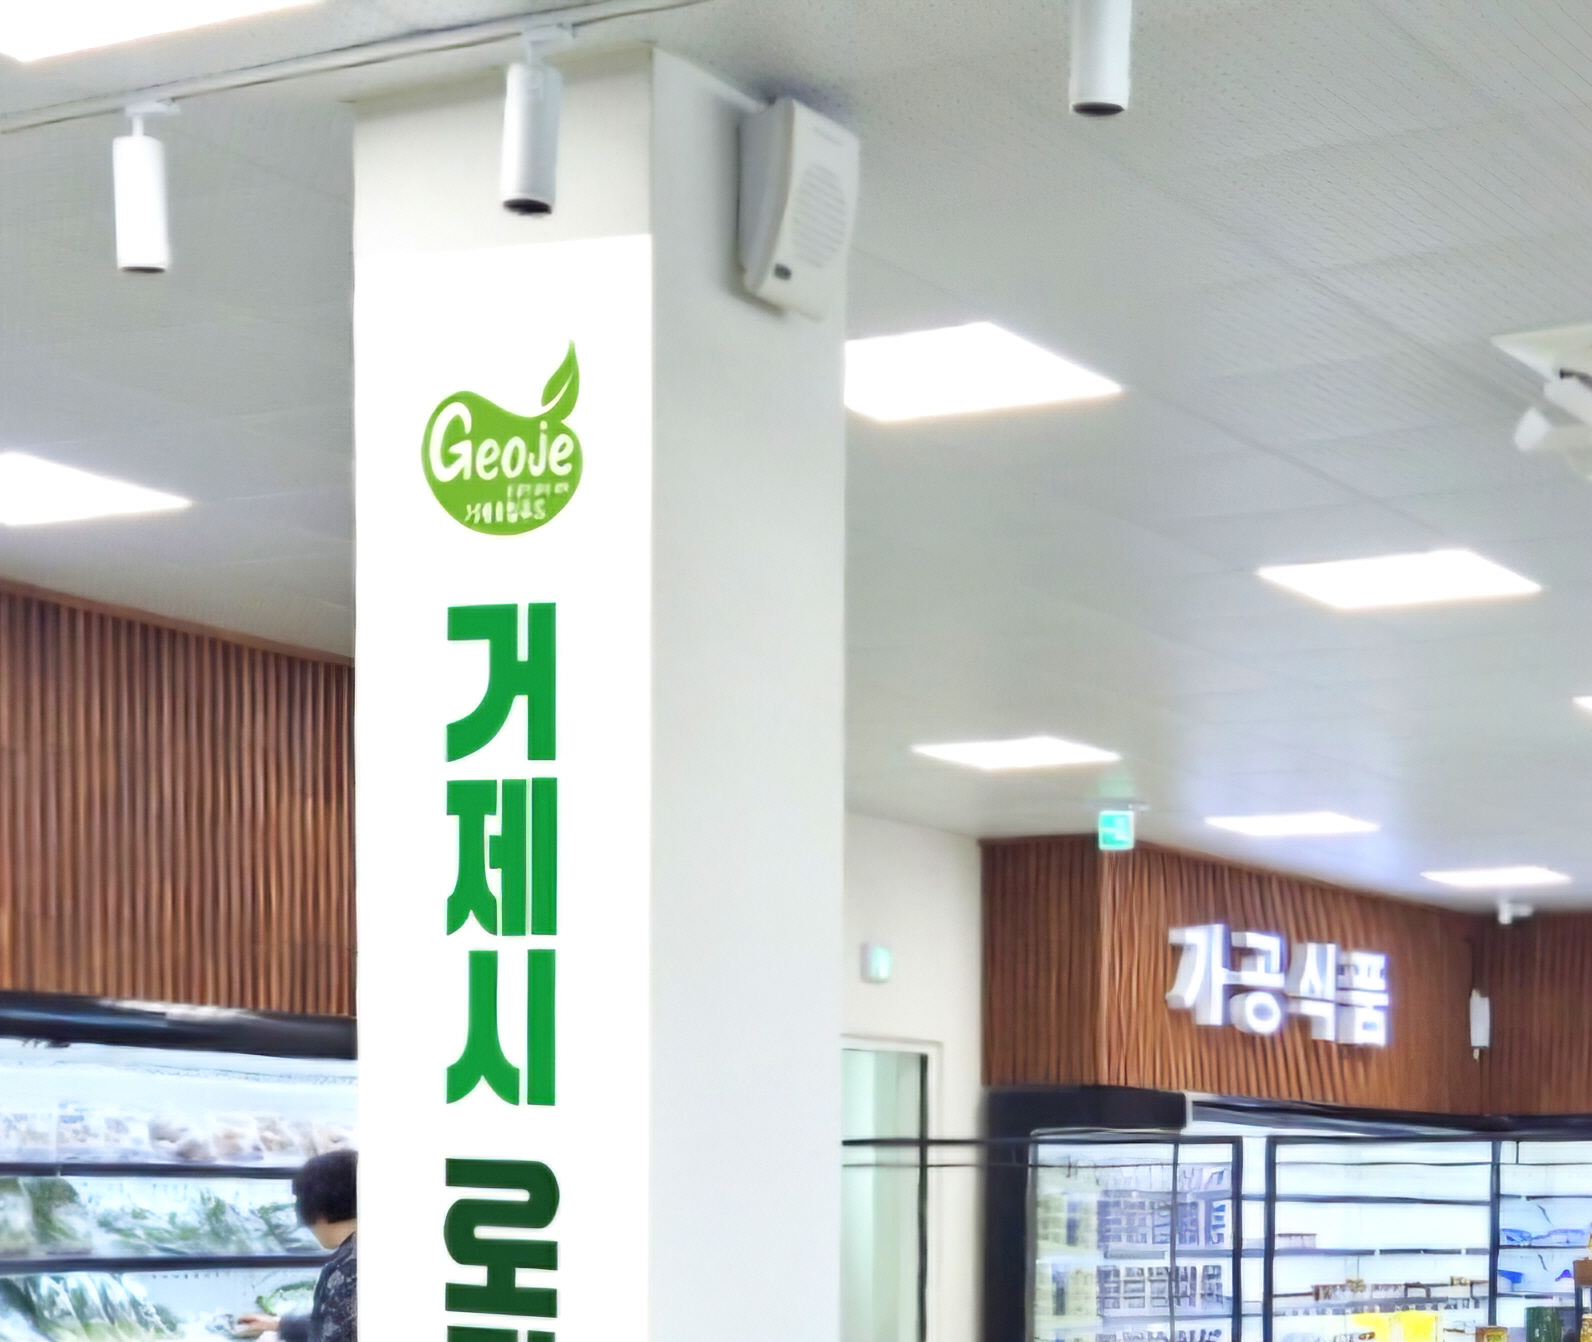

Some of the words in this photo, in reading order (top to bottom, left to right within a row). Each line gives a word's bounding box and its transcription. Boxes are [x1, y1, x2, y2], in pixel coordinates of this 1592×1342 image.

[429, 401, 575, 482] Geoje
[445, 602, 557, 1106] 거제시
[1165, 923, 1390, 1047] 가공식품
